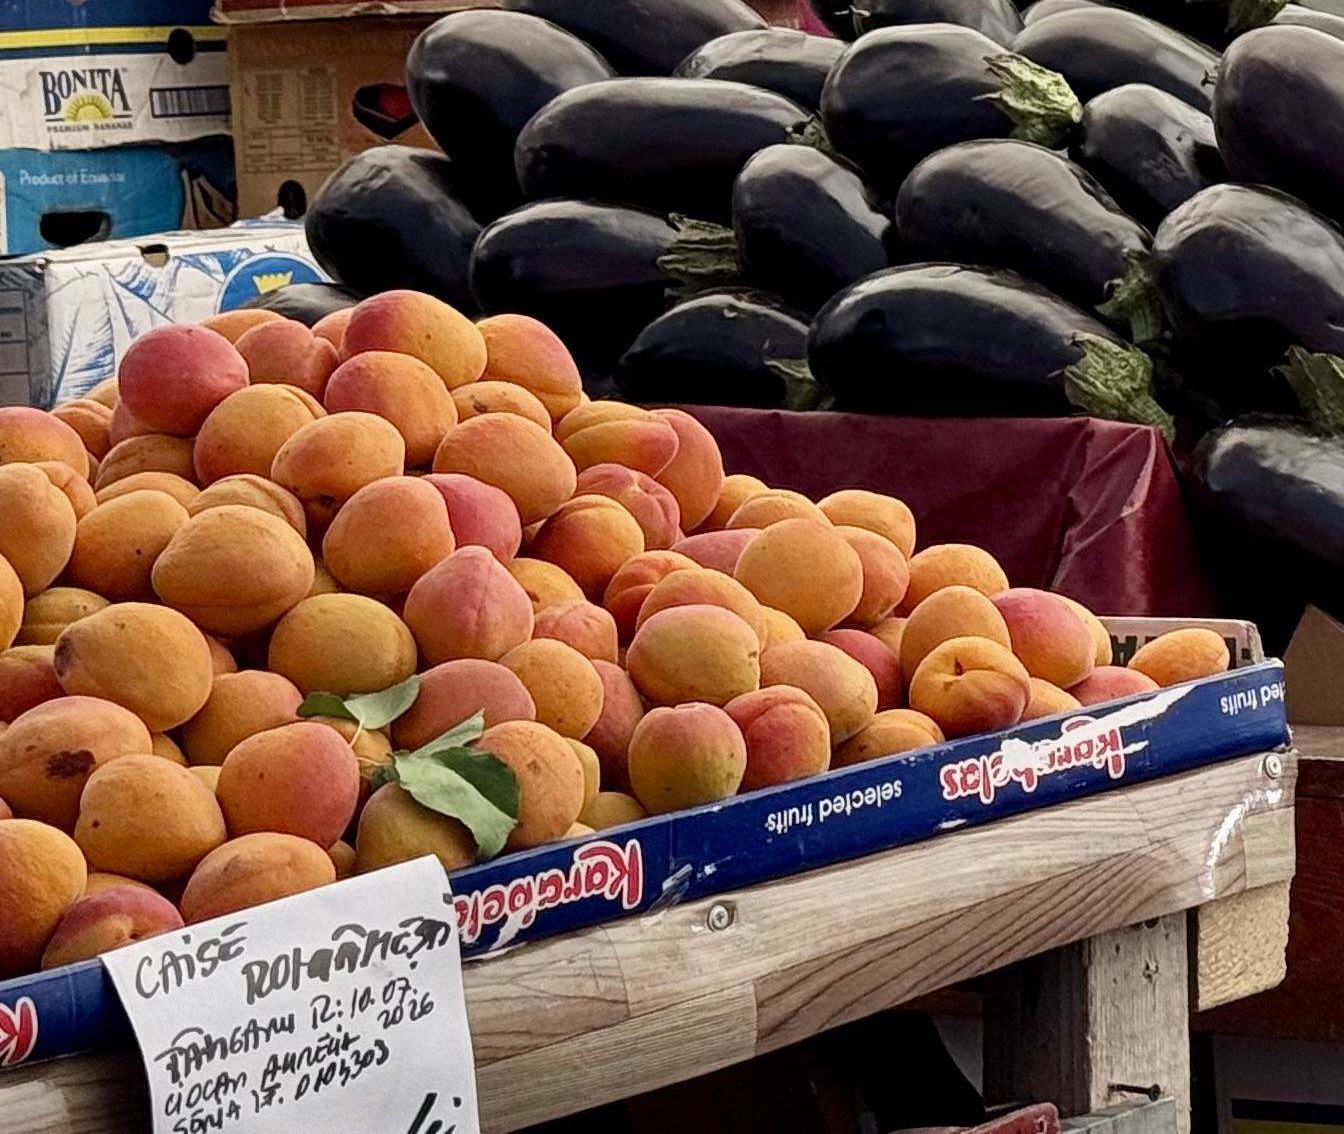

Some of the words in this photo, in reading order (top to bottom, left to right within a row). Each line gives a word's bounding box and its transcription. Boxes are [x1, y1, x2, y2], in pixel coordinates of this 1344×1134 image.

[39, 68, 131, 116] BONITA
[20, 169, 64, 185] Product
[1219, 688, 1258, 717] fruits
[819, 780, 903, 823] selected
[766, 802, 813, 834] fruits
